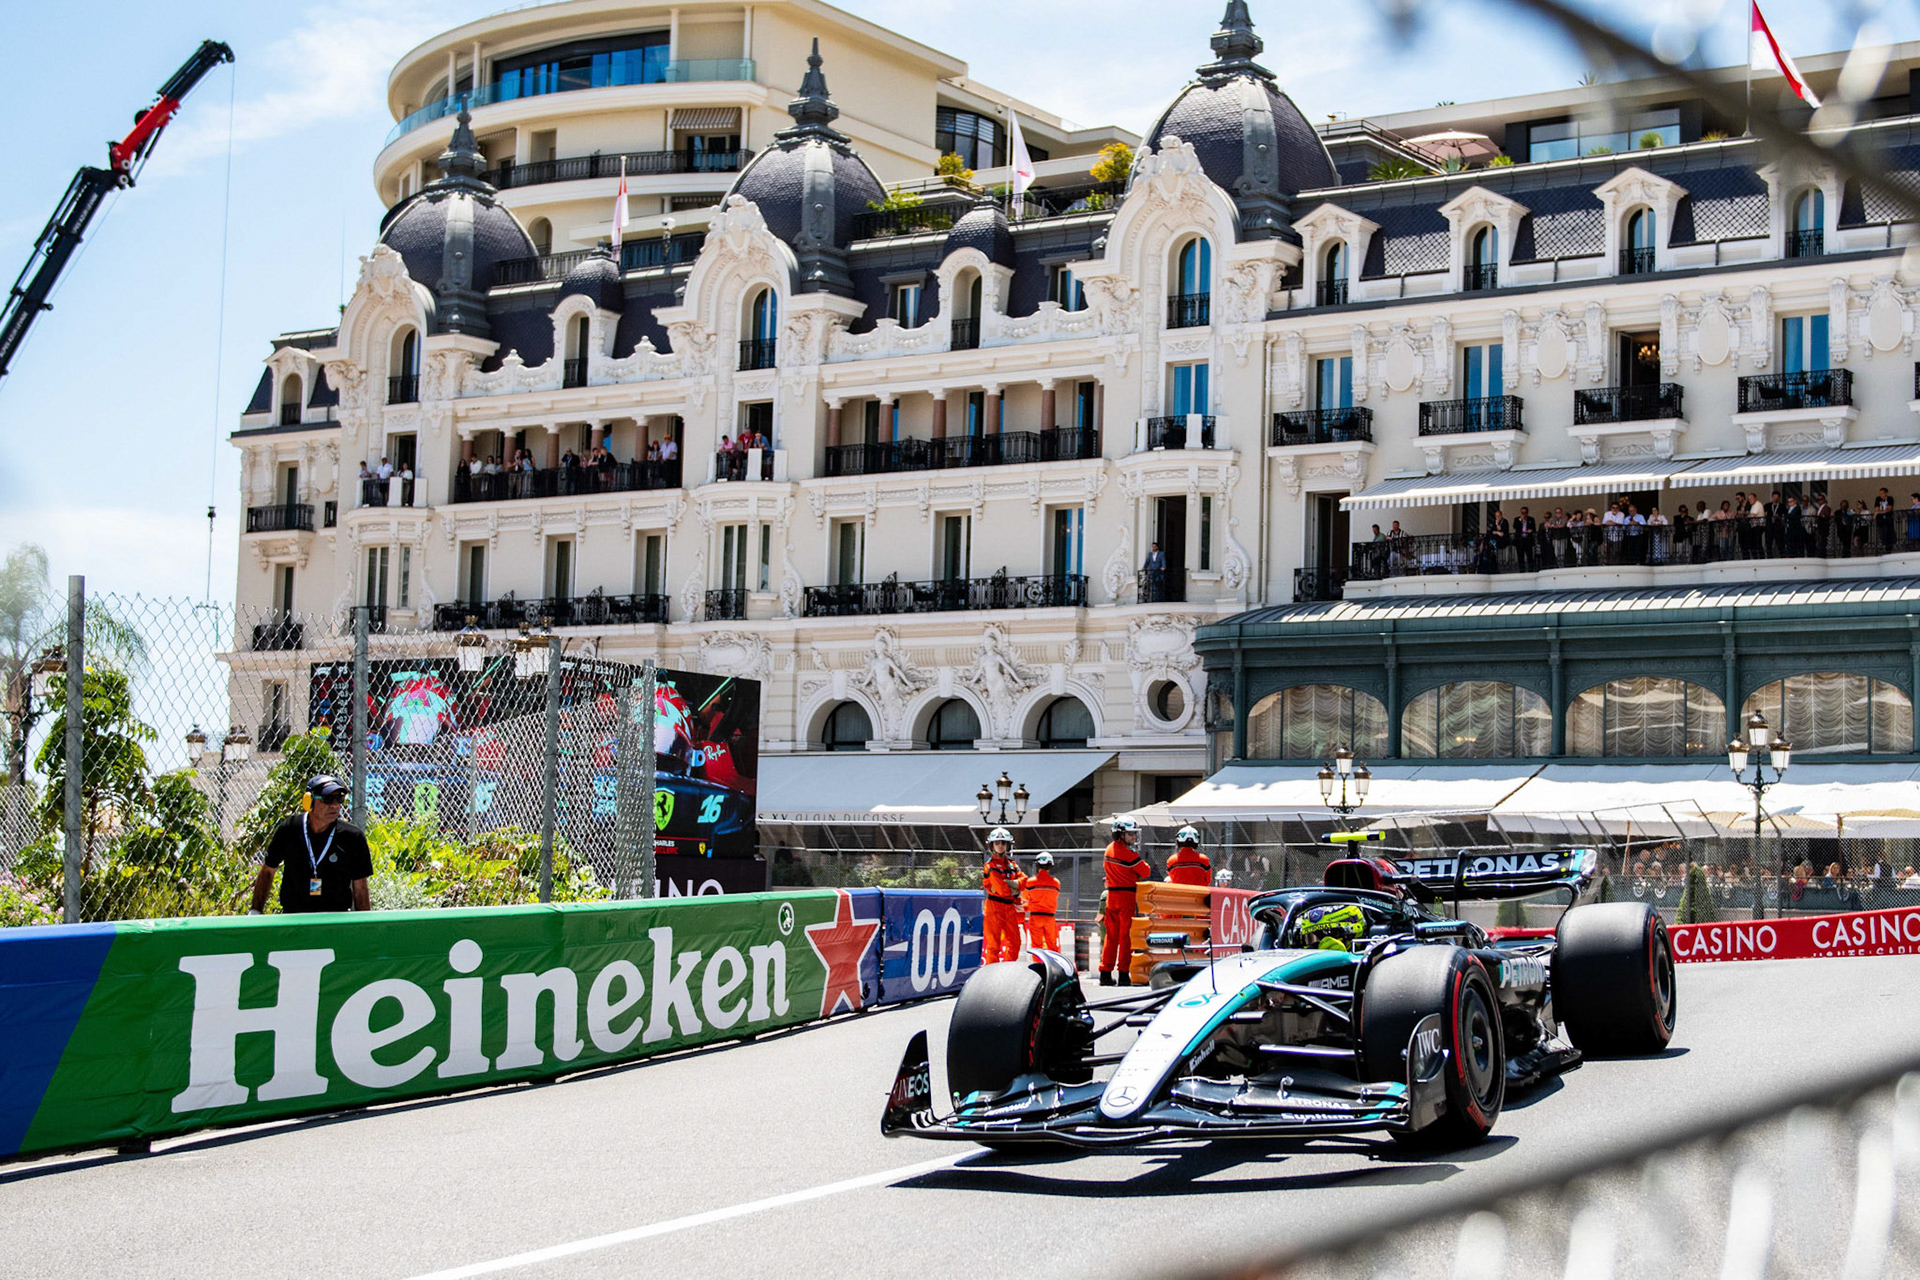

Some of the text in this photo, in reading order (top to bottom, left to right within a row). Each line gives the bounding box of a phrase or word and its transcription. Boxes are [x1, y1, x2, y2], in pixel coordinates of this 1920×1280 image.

[697, 795, 725, 823] 16
[1673, 925, 1777, 956] CASINO
[1812, 912, 1920, 949] CASINO
[911, 907, 962, 993] 0.0
[1321, 975, 1350, 989] AMG
[171, 926, 790, 1114] Heineken
[1416, 1028, 1441, 1059] IWC
[894, 1072, 930, 1102] INEOS
